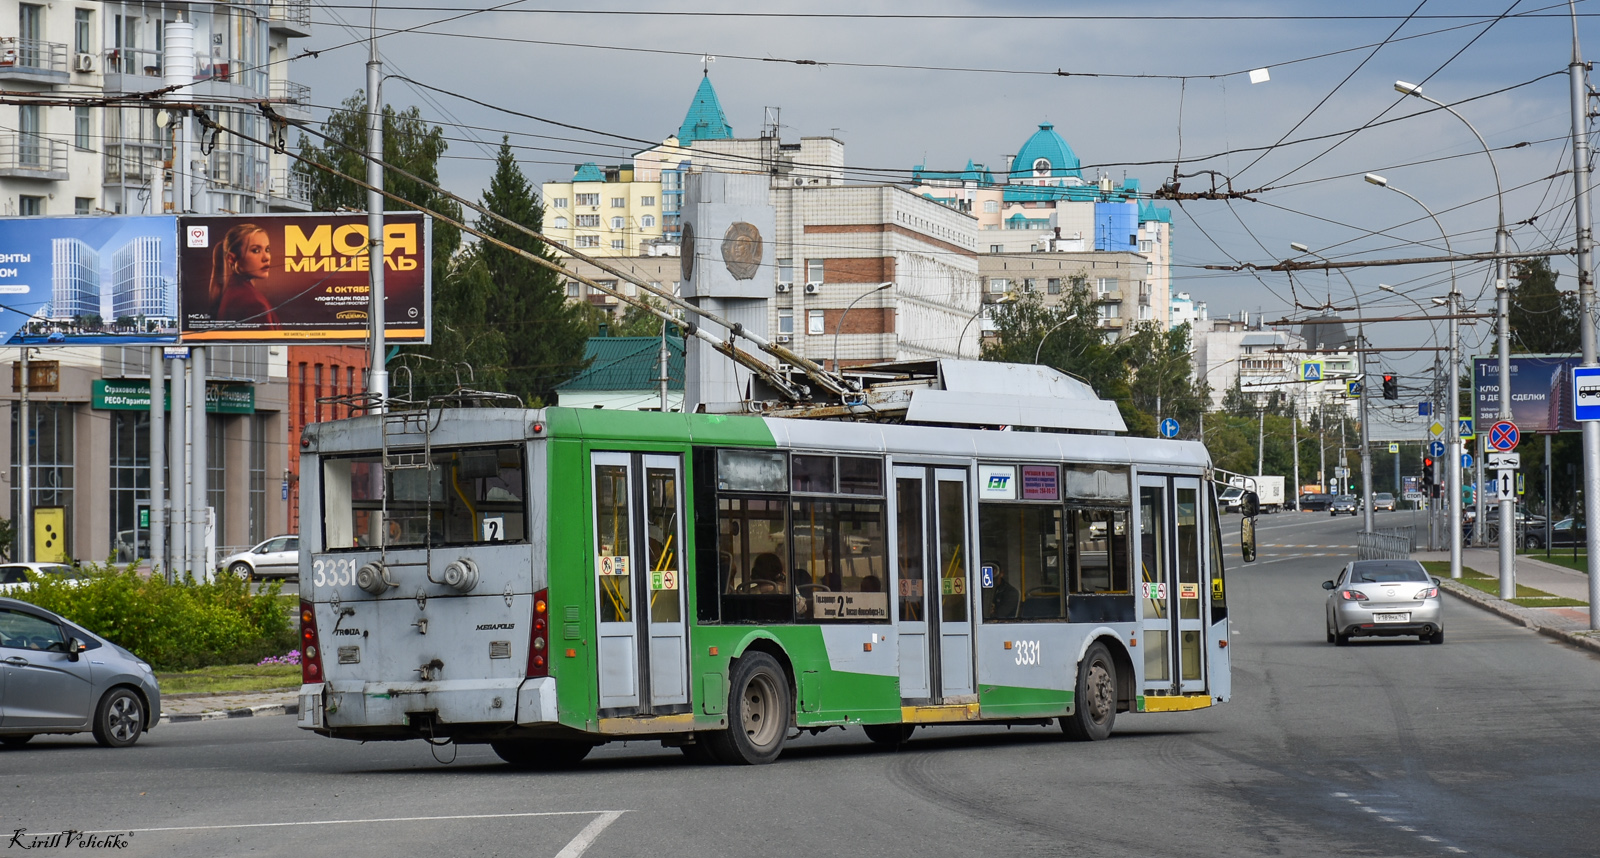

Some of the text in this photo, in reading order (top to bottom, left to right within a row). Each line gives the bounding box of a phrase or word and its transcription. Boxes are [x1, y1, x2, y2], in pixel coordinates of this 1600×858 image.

[285, 223, 417, 257] МОЯ
[334, 285, 370, 293] ОКТЯБР
[104, 385, 136, 395] Страховое
[1511, 393, 1545, 402] СДЕЛКИ
[104, 396, 151, 406] РЕСО-Гарантия
[489, 521, 498, 541] 2
[313, 559, 357, 587] 3331
[837, 595, 844, 617] 2
[475, 623, 515, 631] MEGAPOLIS
[1014, 640, 1040, 666] 3331
